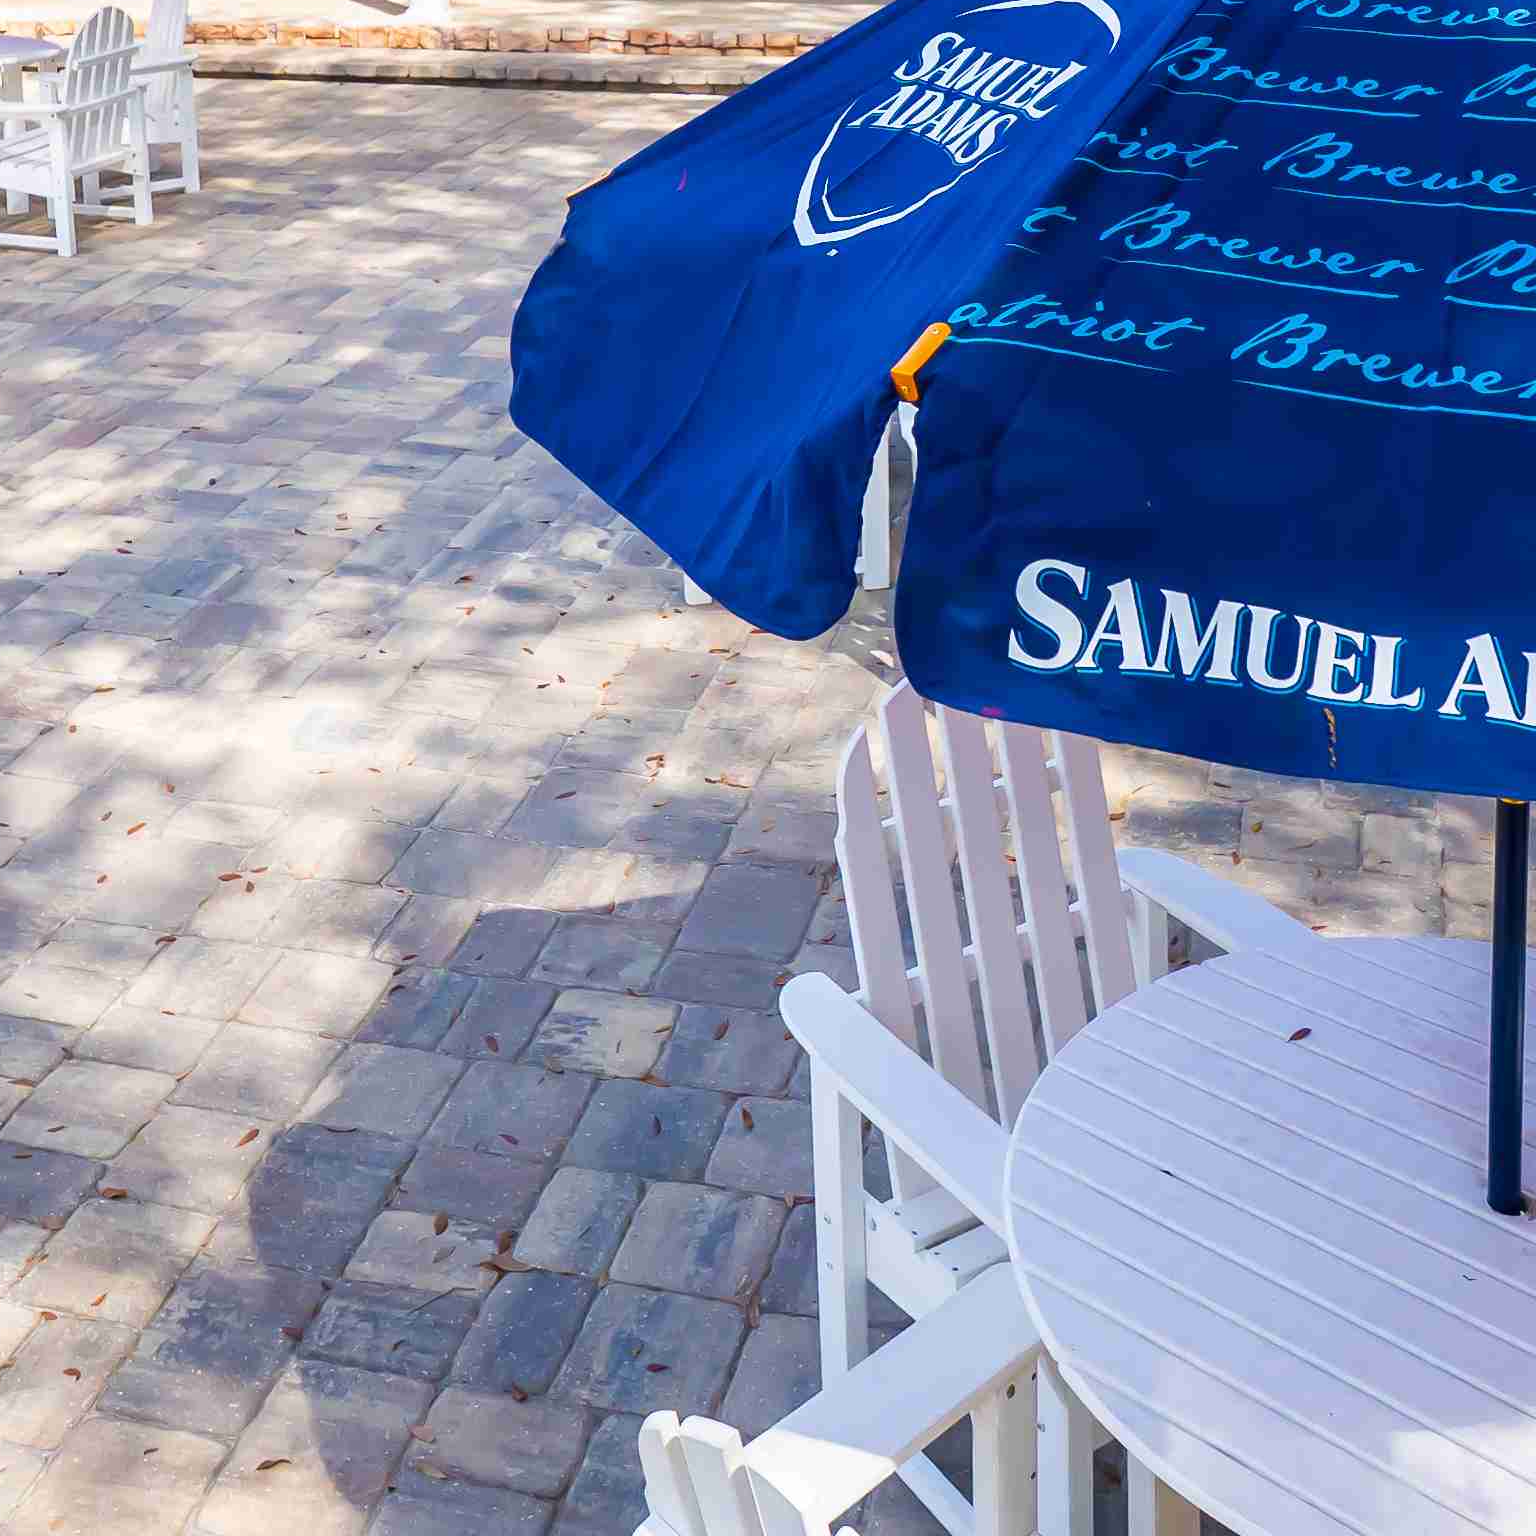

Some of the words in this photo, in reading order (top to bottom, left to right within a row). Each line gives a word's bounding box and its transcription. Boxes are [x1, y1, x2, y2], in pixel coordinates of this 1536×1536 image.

[892, 31, 1088, 121] SAMUEL
[1151, 36, 1445, 101] Brewer
[849, 84, 1012, 166] ADAMS
[1087, 127, 1240, 168] riot
[1099, 202, 1425, 280] Brewer
[947, 293, 1206, 351] atriot
[1008, 558, 1424, 711] SAMUEL
